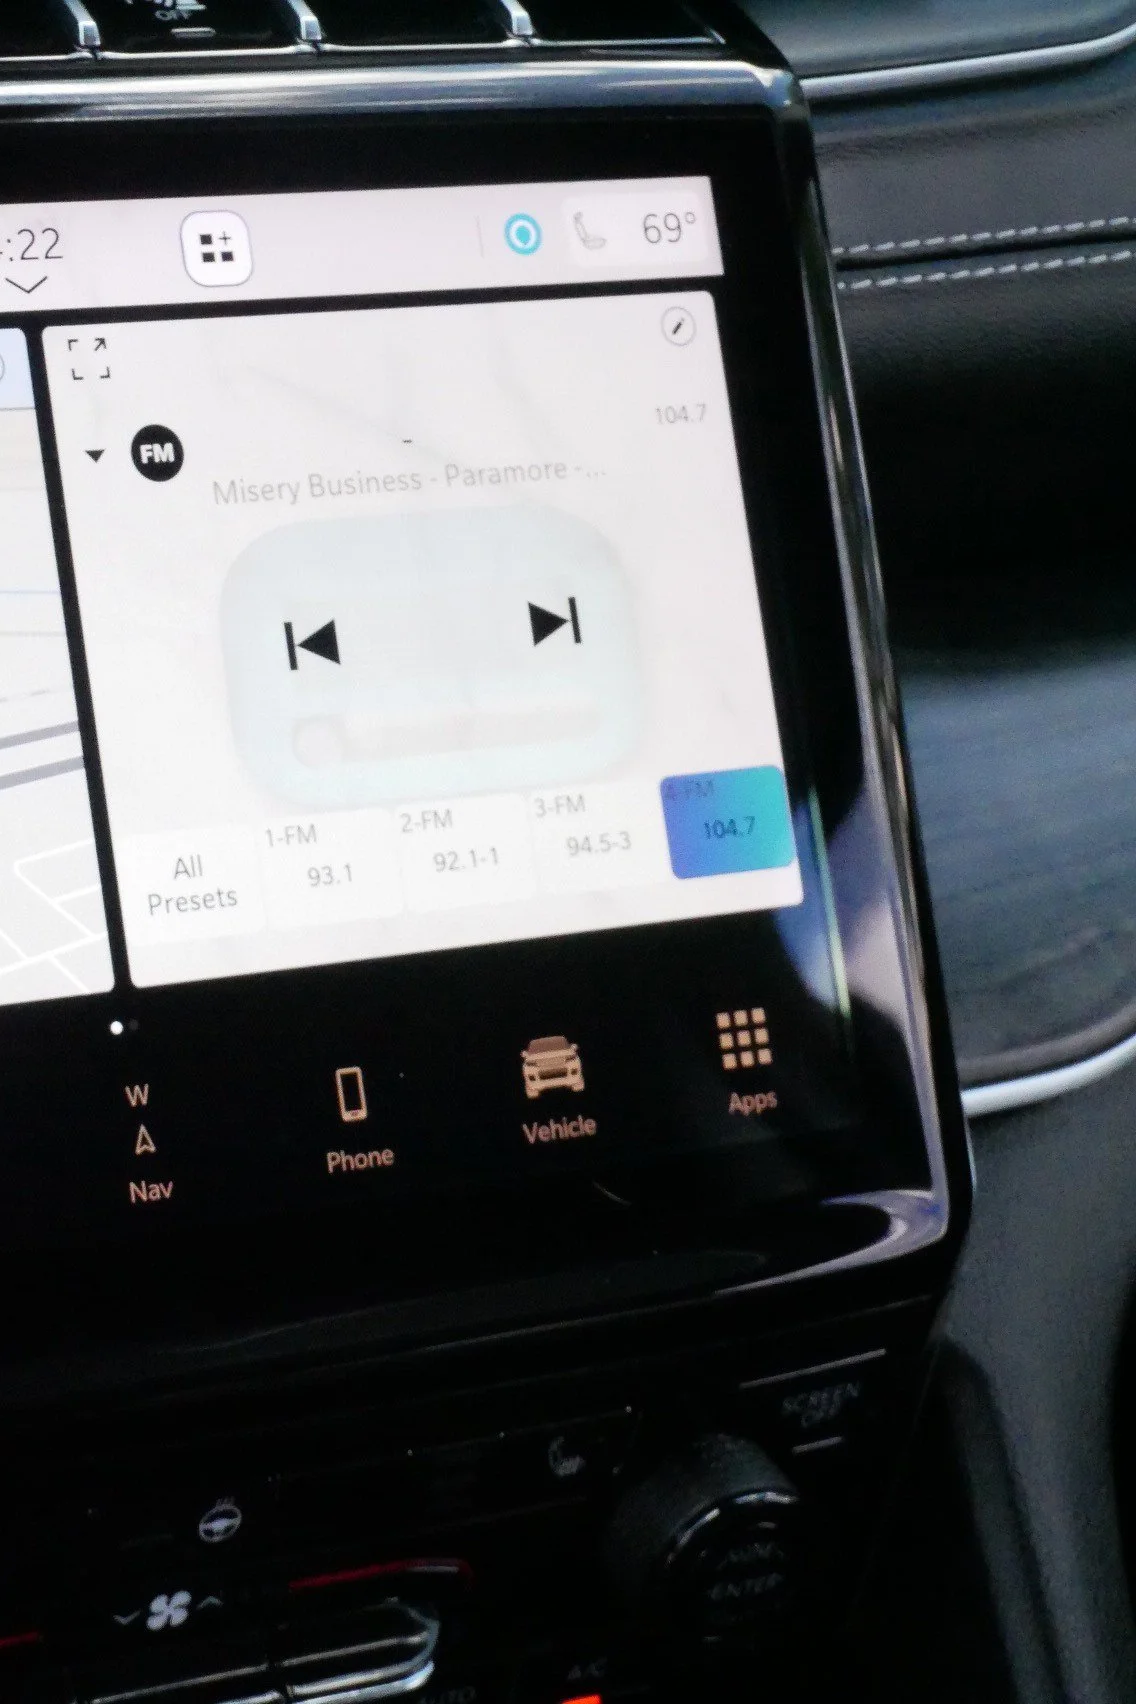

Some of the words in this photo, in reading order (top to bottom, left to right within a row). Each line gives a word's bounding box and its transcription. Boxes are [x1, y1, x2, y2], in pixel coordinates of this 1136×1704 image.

[642, 208, 698, 245] 69°
[655, 403, 708, 426] 104.7
[139, 444, 176, 465] FM
[212, 475, 301, 508] Misery
[309, 468, 422, 499] Business
[445, 458, 568, 489] Paramore
[534, 793, 587, 818] 3-FM
[401, 808, 454, 834] 2-FM
[704, 816, 756, 840] 104.7
[265, 823, 317, 849] 1-FM
[566, 831, 632, 858] 94.5-3
[172, 853, 204, 880] All
[432, 847, 500, 874] 92.1-1
[307, 862, 354, 888] 93.1
[147, 886, 238, 916] Presets
[125, 1085, 151, 1107] W
[728, 1090, 778, 1118] Apps
[522, 1115, 598, 1144] Vehicle
[326, 1145, 395, 1174] Phone
[129, 1178, 173, 1204] Nav
